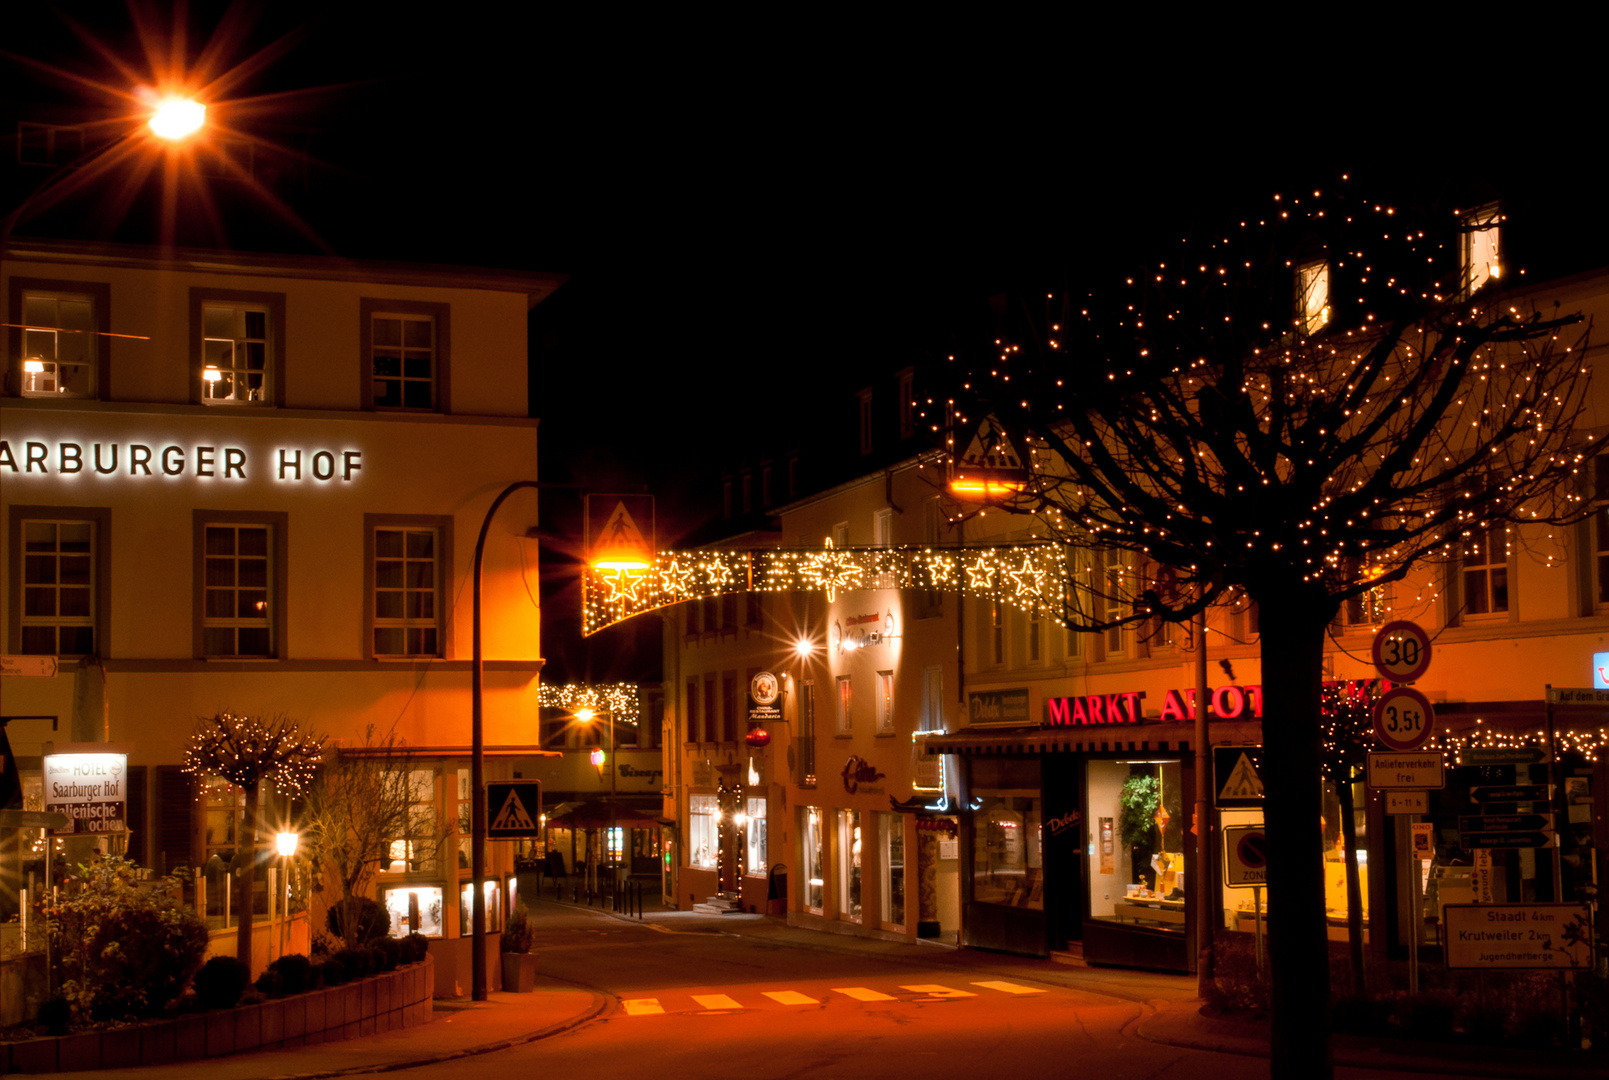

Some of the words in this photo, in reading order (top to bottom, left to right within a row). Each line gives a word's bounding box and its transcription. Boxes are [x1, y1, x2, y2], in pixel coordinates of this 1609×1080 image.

[0, 441, 246, 478] ARBURGER
[278, 449, 362, 480] HOF
[1385, 638, 1418, 666] 30
[1560, 691, 1573, 702] Auf
[1576, 691, 1594, 702] dem
[1048, 692, 1139, 726] MARKT
[1386, 706, 1420, 732] 3,5t
[73, 763, 107, 776] HOTEL
[1375, 759, 1436, 769] Anlieferverkehr
[1397, 773, 1415, 782] frei
[53, 781, 102, 802] Saarburger
[104, 780, 120, 796] Hof
[1416, 799, 1422, 807] h
[1487, 911, 1526, 922] Staadt
[1459, 931, 1523, 941] Krutweiler
[1479, 953, 1554, 963] Jugendherberge
